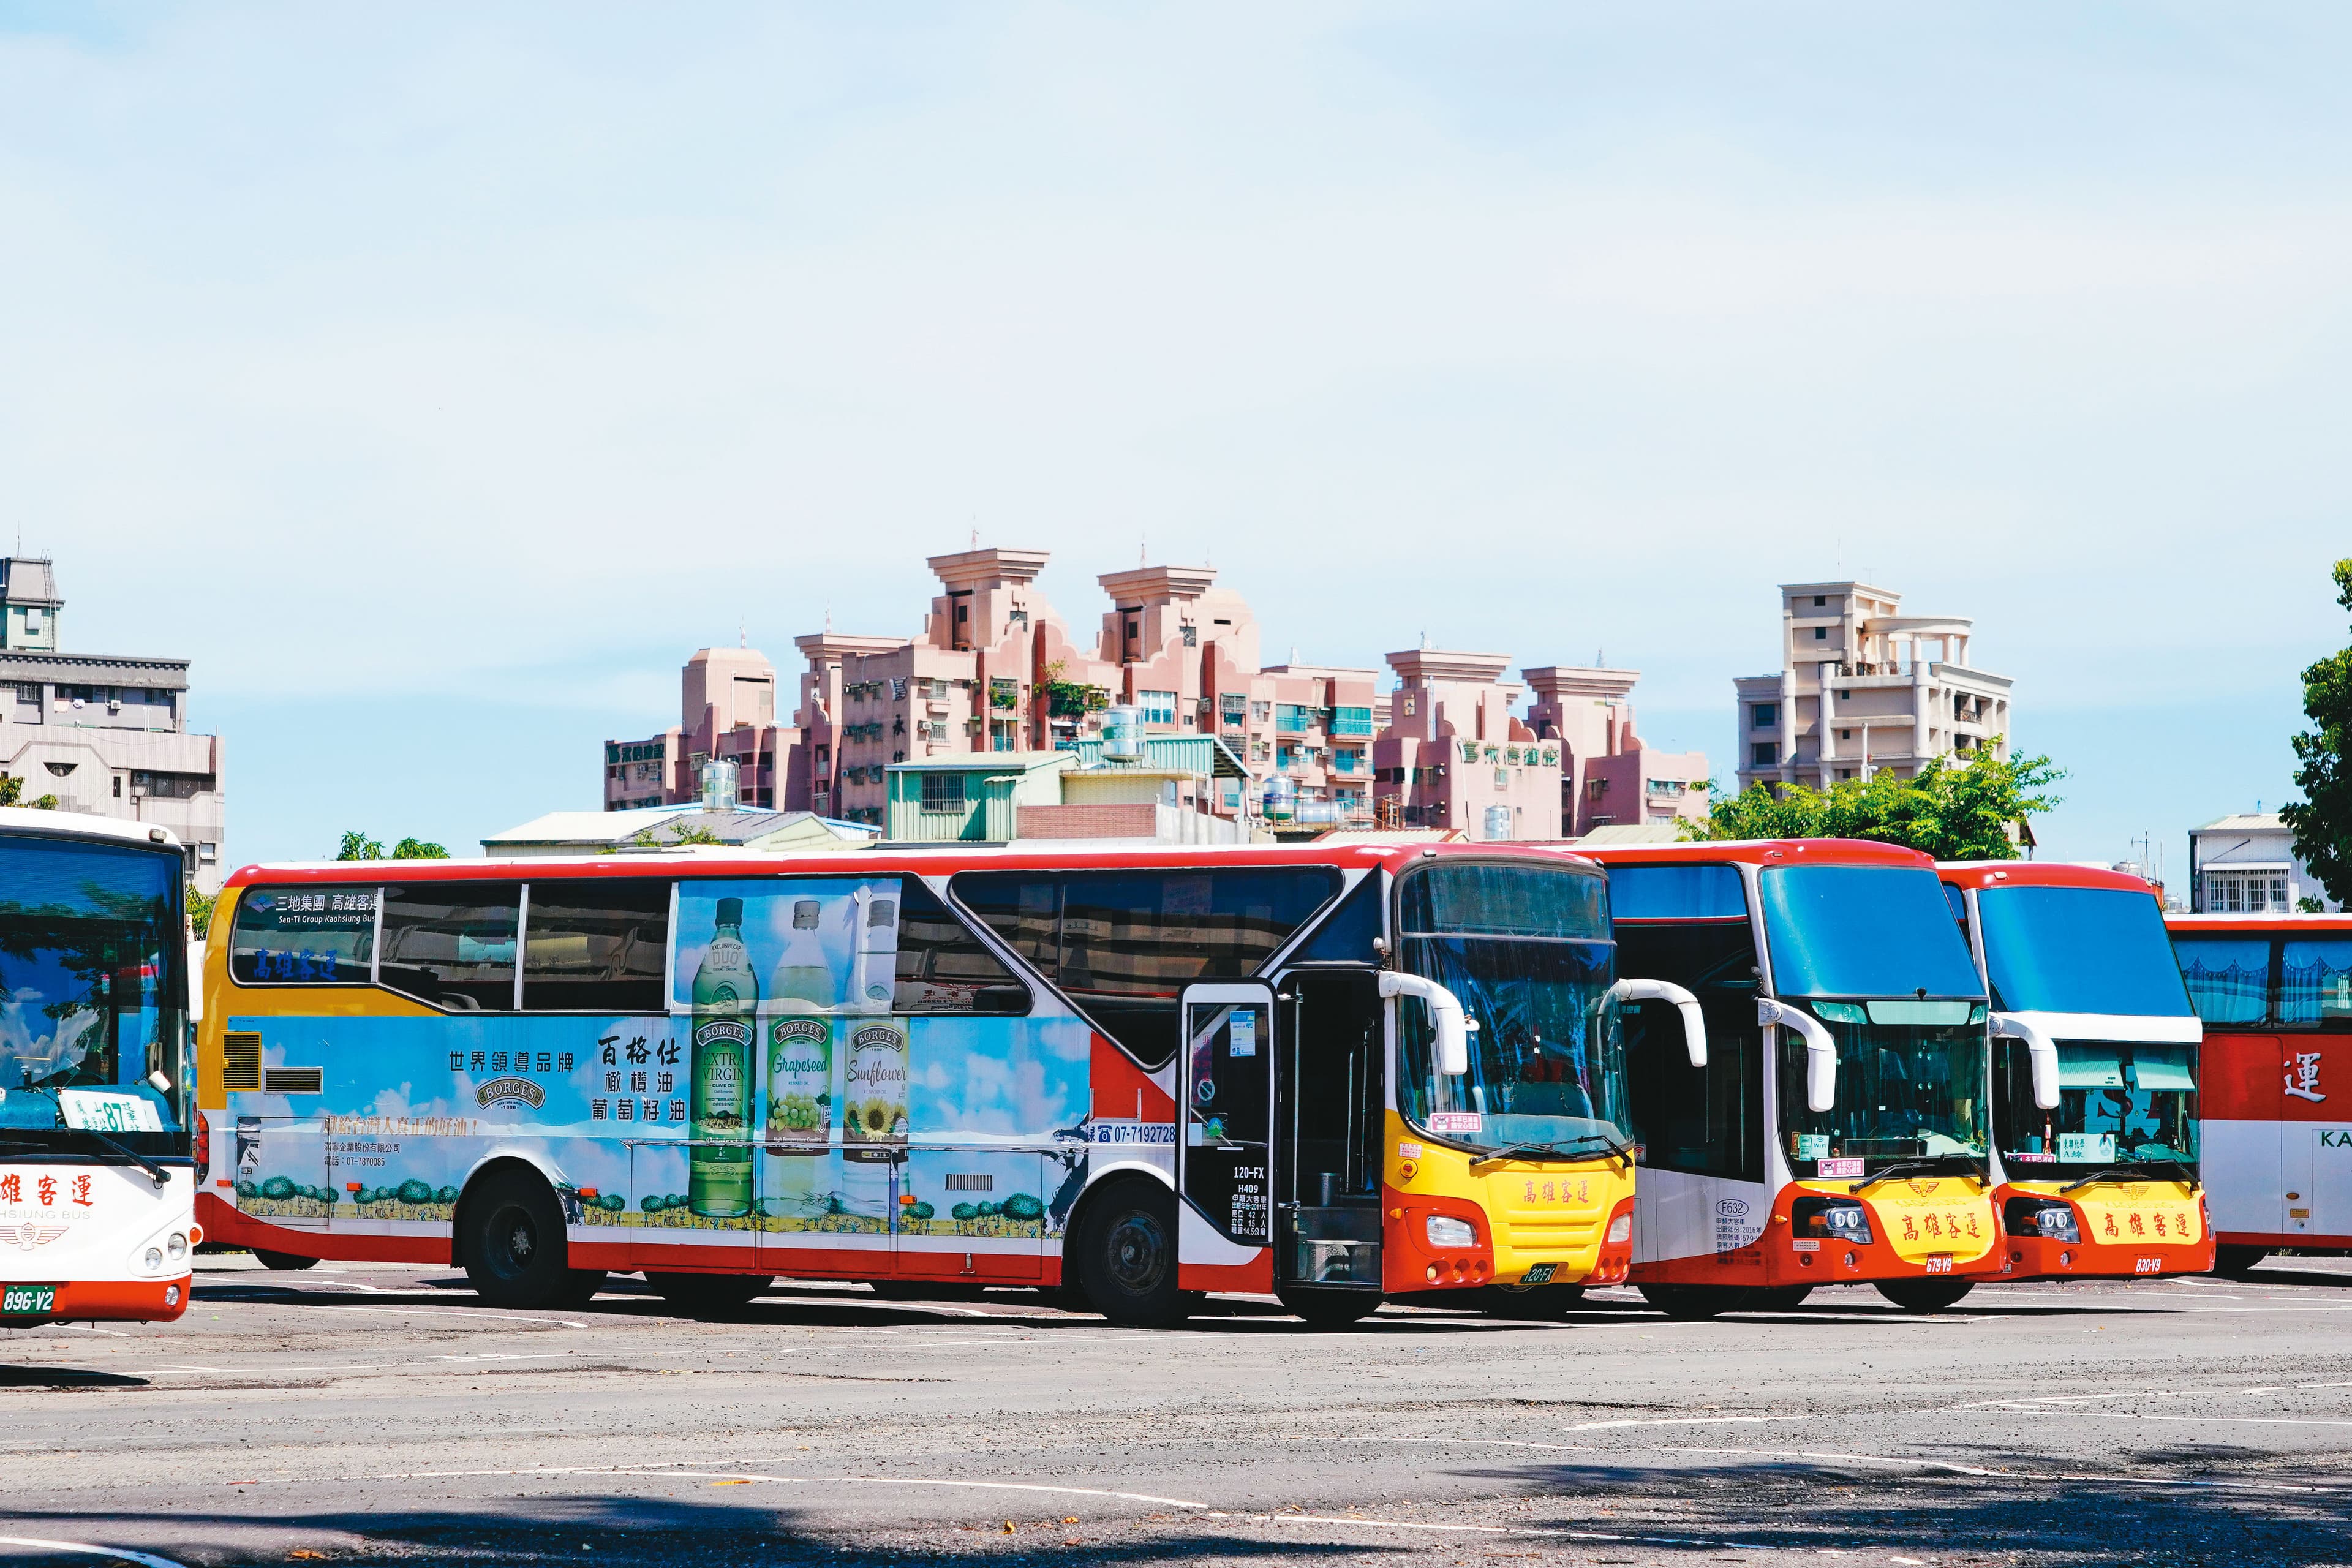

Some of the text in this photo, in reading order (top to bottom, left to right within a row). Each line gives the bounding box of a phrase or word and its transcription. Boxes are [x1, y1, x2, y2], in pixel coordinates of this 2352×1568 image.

[276, 895, 325, 912] 三地集團
[279, 914, 375, 925] San-Ti Group Kaohsiung Bus
[254, 948, 338, 981] 高雄客運
[704, 1026, 745, 1039] BORGES
[780, 1023, 821, 1036] BORGES
[858, 1030, 898, 1044] BORGES
[597, 1035, 682, 1067] 百格仕
[703, 1052, 745, 1066] EXTRA
[449, 1050, 575, 1074] 世界領導品牌
[772, 1053, 828, 1079] Grapeseed
[702, 1068, 745, 1080] VIRGIN
[846, 1059, 907, 1087] Sunflower
[2283, 1052, 2327, 1102] 運
[484, 1079, 536, 1101] BORGES
[604, 1071, 674, 1094] 橄欖油
[103, 1102, 126, 1132] 87
[591, 1099, 687, 1121] 葡萄籽油
[1115, 1126, 1176, 1142] 07-7192728
[2321, 1131, 2352, 1147] KA
[1234, 1166, 1264, 1179] 120-FX
[0, 1173, 94, 1207] 雄客運
[1238, 1184, 1259, 1193] H409
[1524, 1180, 1588, 1204] 高雄客運
[62, 1210, 91, 1219] BUS
[1722, 1202, 1743, 1214] F632
[1902, 1212, 1980, 1241] 高雄客運
[2104, 1212, 2190, 1238] 高雄客運
[1926, 1257, 1953, 1273] 679-V9
[2136, 1258, 2162, 1272] 830-V9
[1524, 1268, 1555, 1282] 120-FX
[3, 1291, 55, 1311] 896-V2
